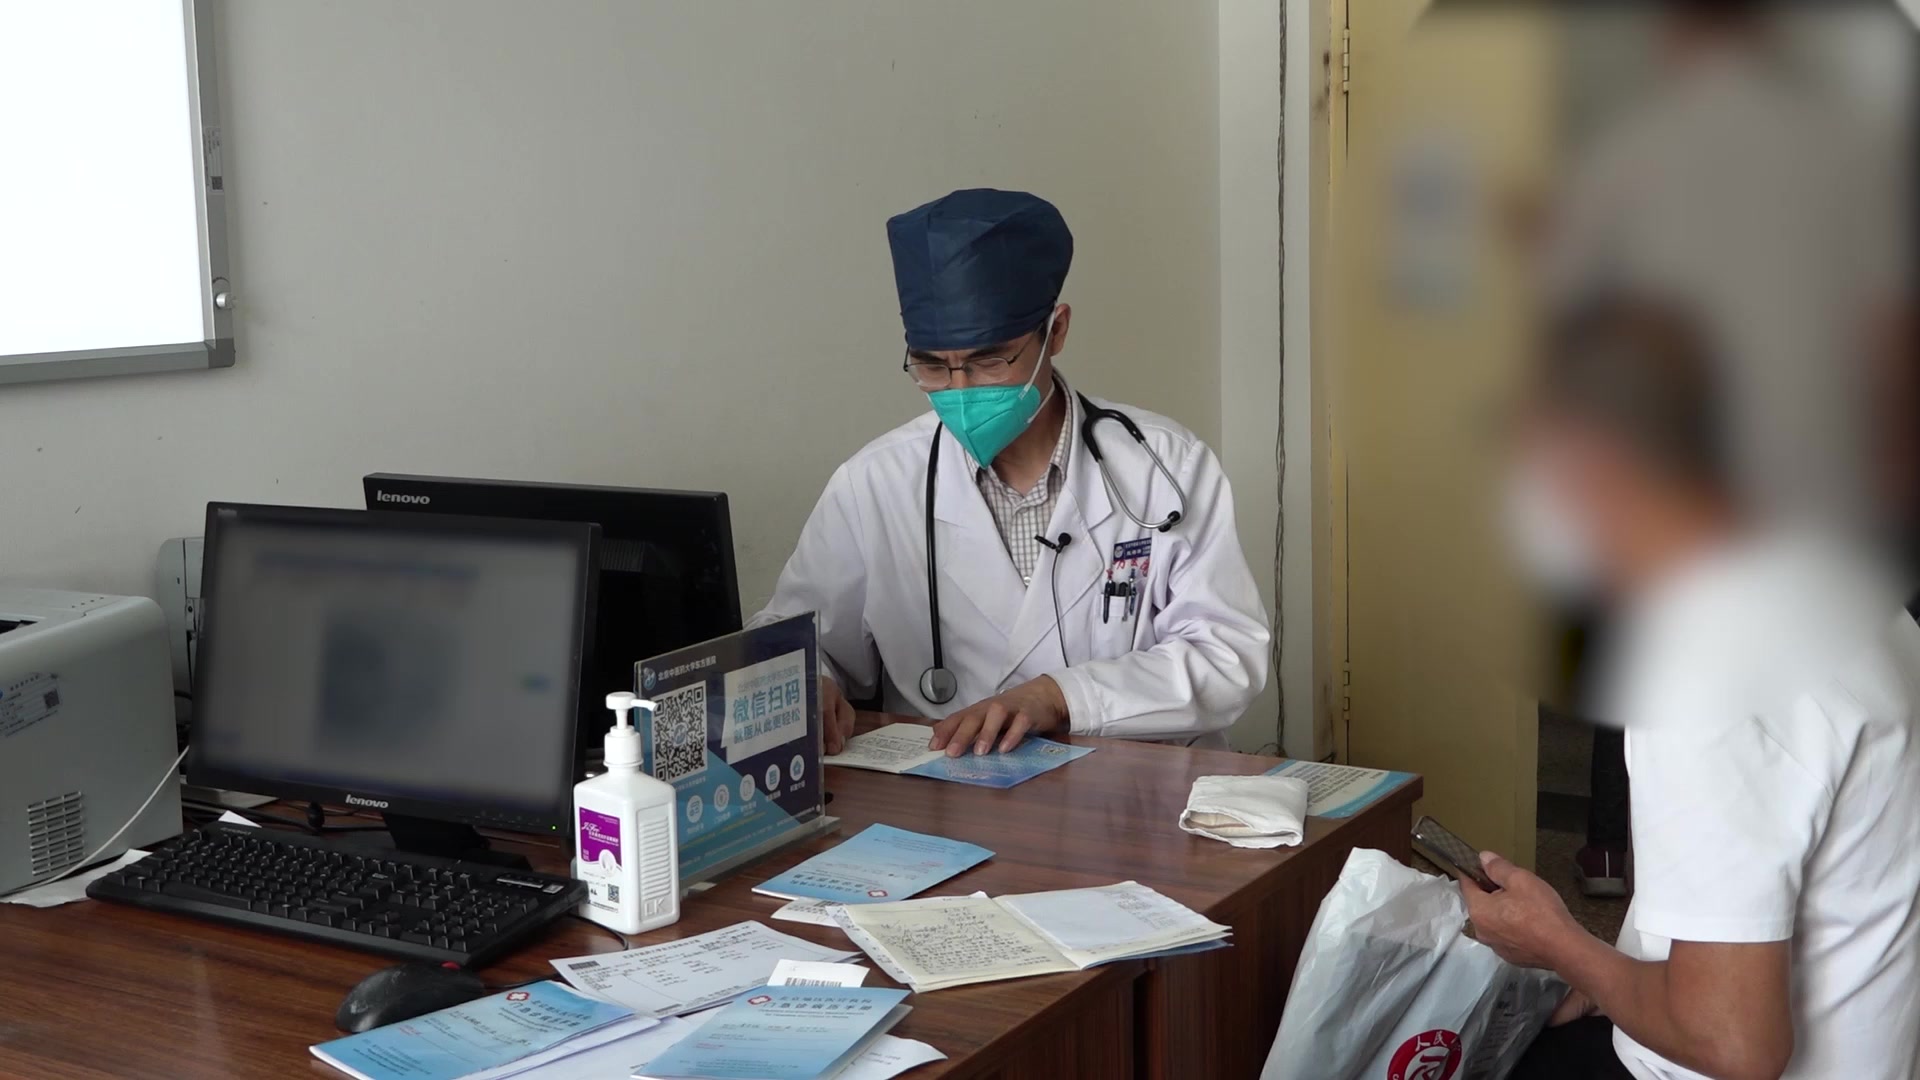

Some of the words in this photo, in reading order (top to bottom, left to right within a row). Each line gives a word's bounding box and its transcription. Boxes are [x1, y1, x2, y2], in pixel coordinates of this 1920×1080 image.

[377, 490, 430, 504] lenovo
[733, 679, 800, 723] 微信扫码
[734, 709, 801, 744] 就医从此更轻松
[345, 793, 389, 809] lenovo
